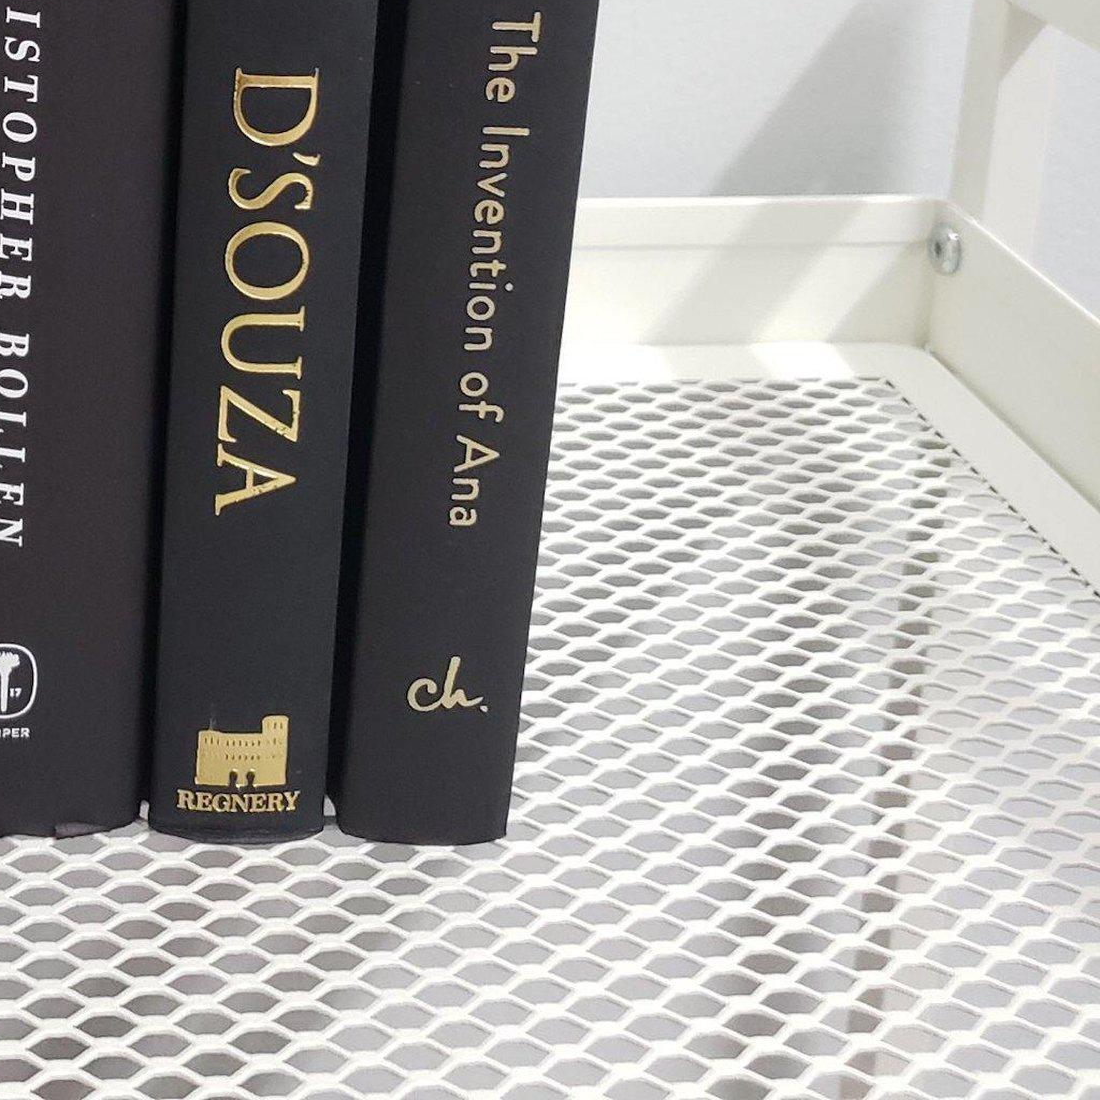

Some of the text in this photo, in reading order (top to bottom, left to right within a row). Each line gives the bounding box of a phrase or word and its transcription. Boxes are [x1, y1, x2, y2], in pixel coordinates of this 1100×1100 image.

[450, 12, 541, 526] The Invention of Ana
[9, 687, 22, 697] 17
[177, 788, 300, 813] REGNERY
